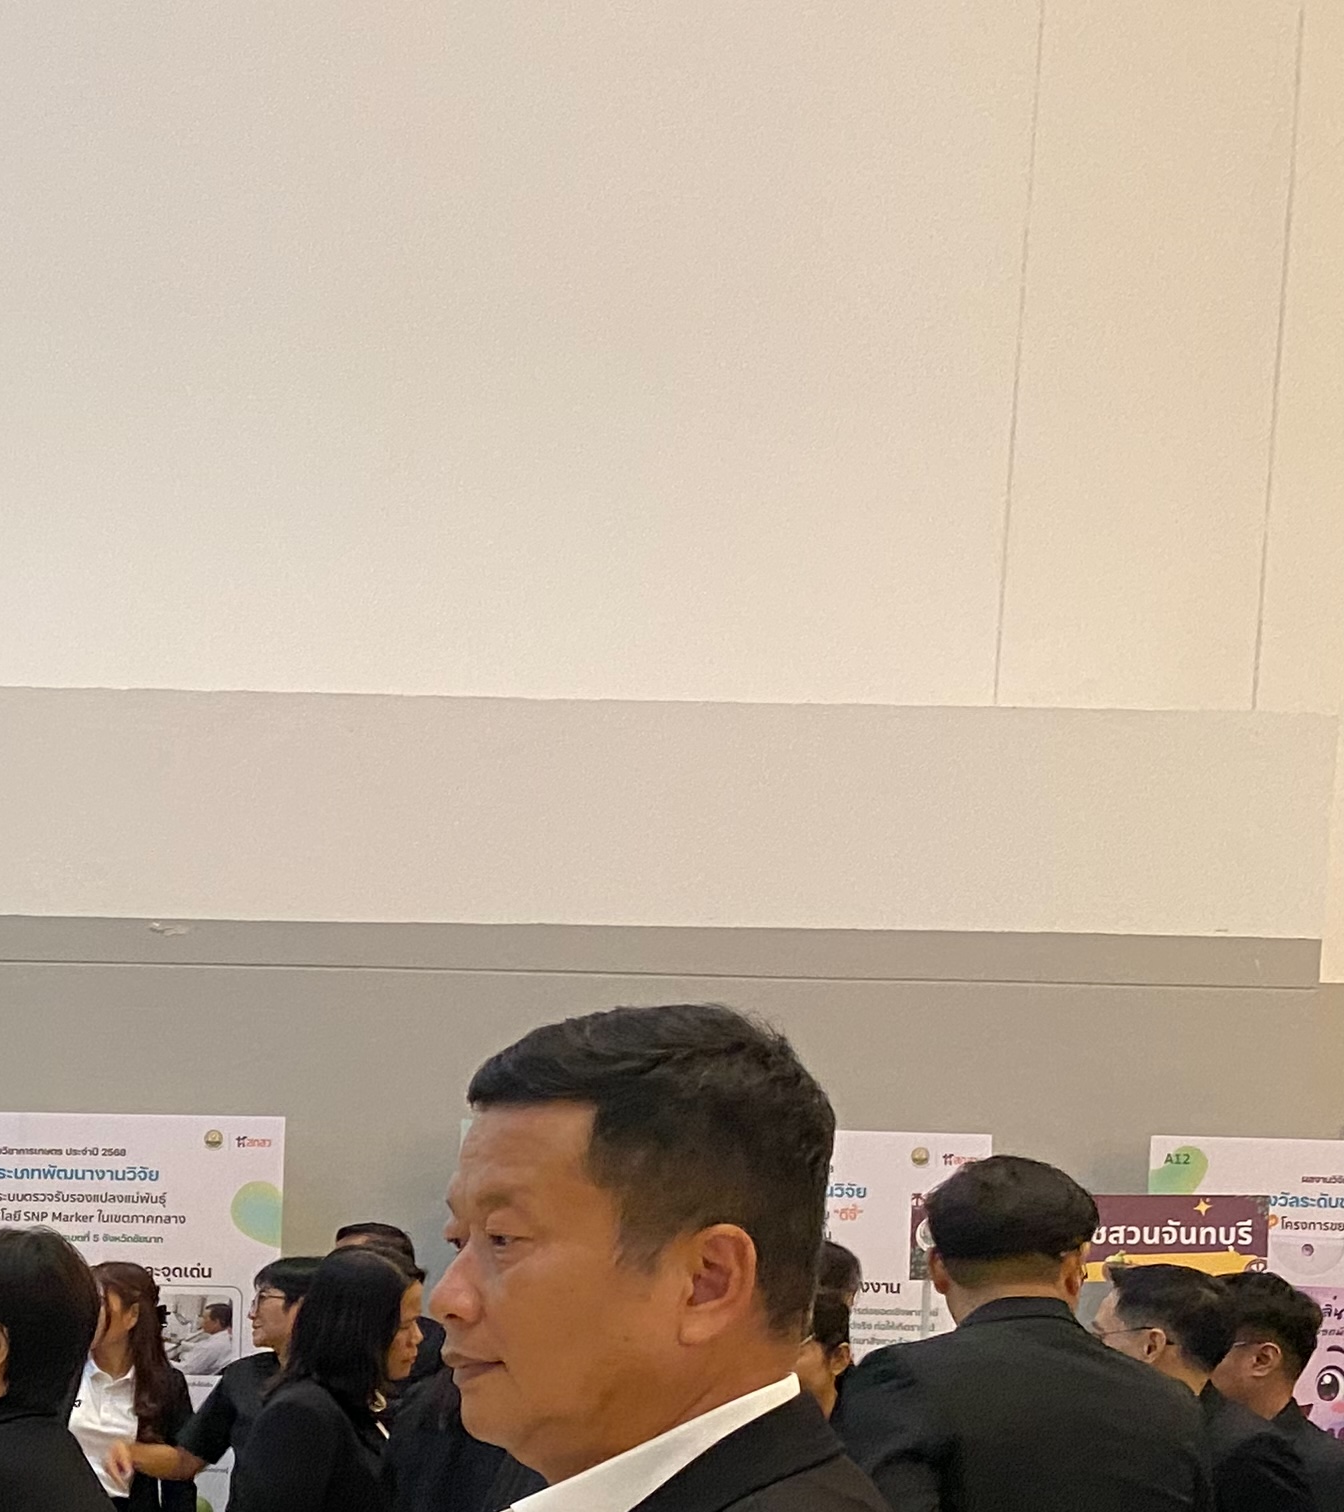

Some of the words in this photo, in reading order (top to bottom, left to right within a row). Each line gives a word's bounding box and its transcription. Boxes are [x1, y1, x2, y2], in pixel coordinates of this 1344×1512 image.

[23, 1211, 48, 1222] SNP
[51, 1211, 94, 1223] Marker
[97, 1209, 187, 1225] ในเขตภาคกลาง
[1091, 1219, 1253, 1252] ชสวนจันทบุรี
